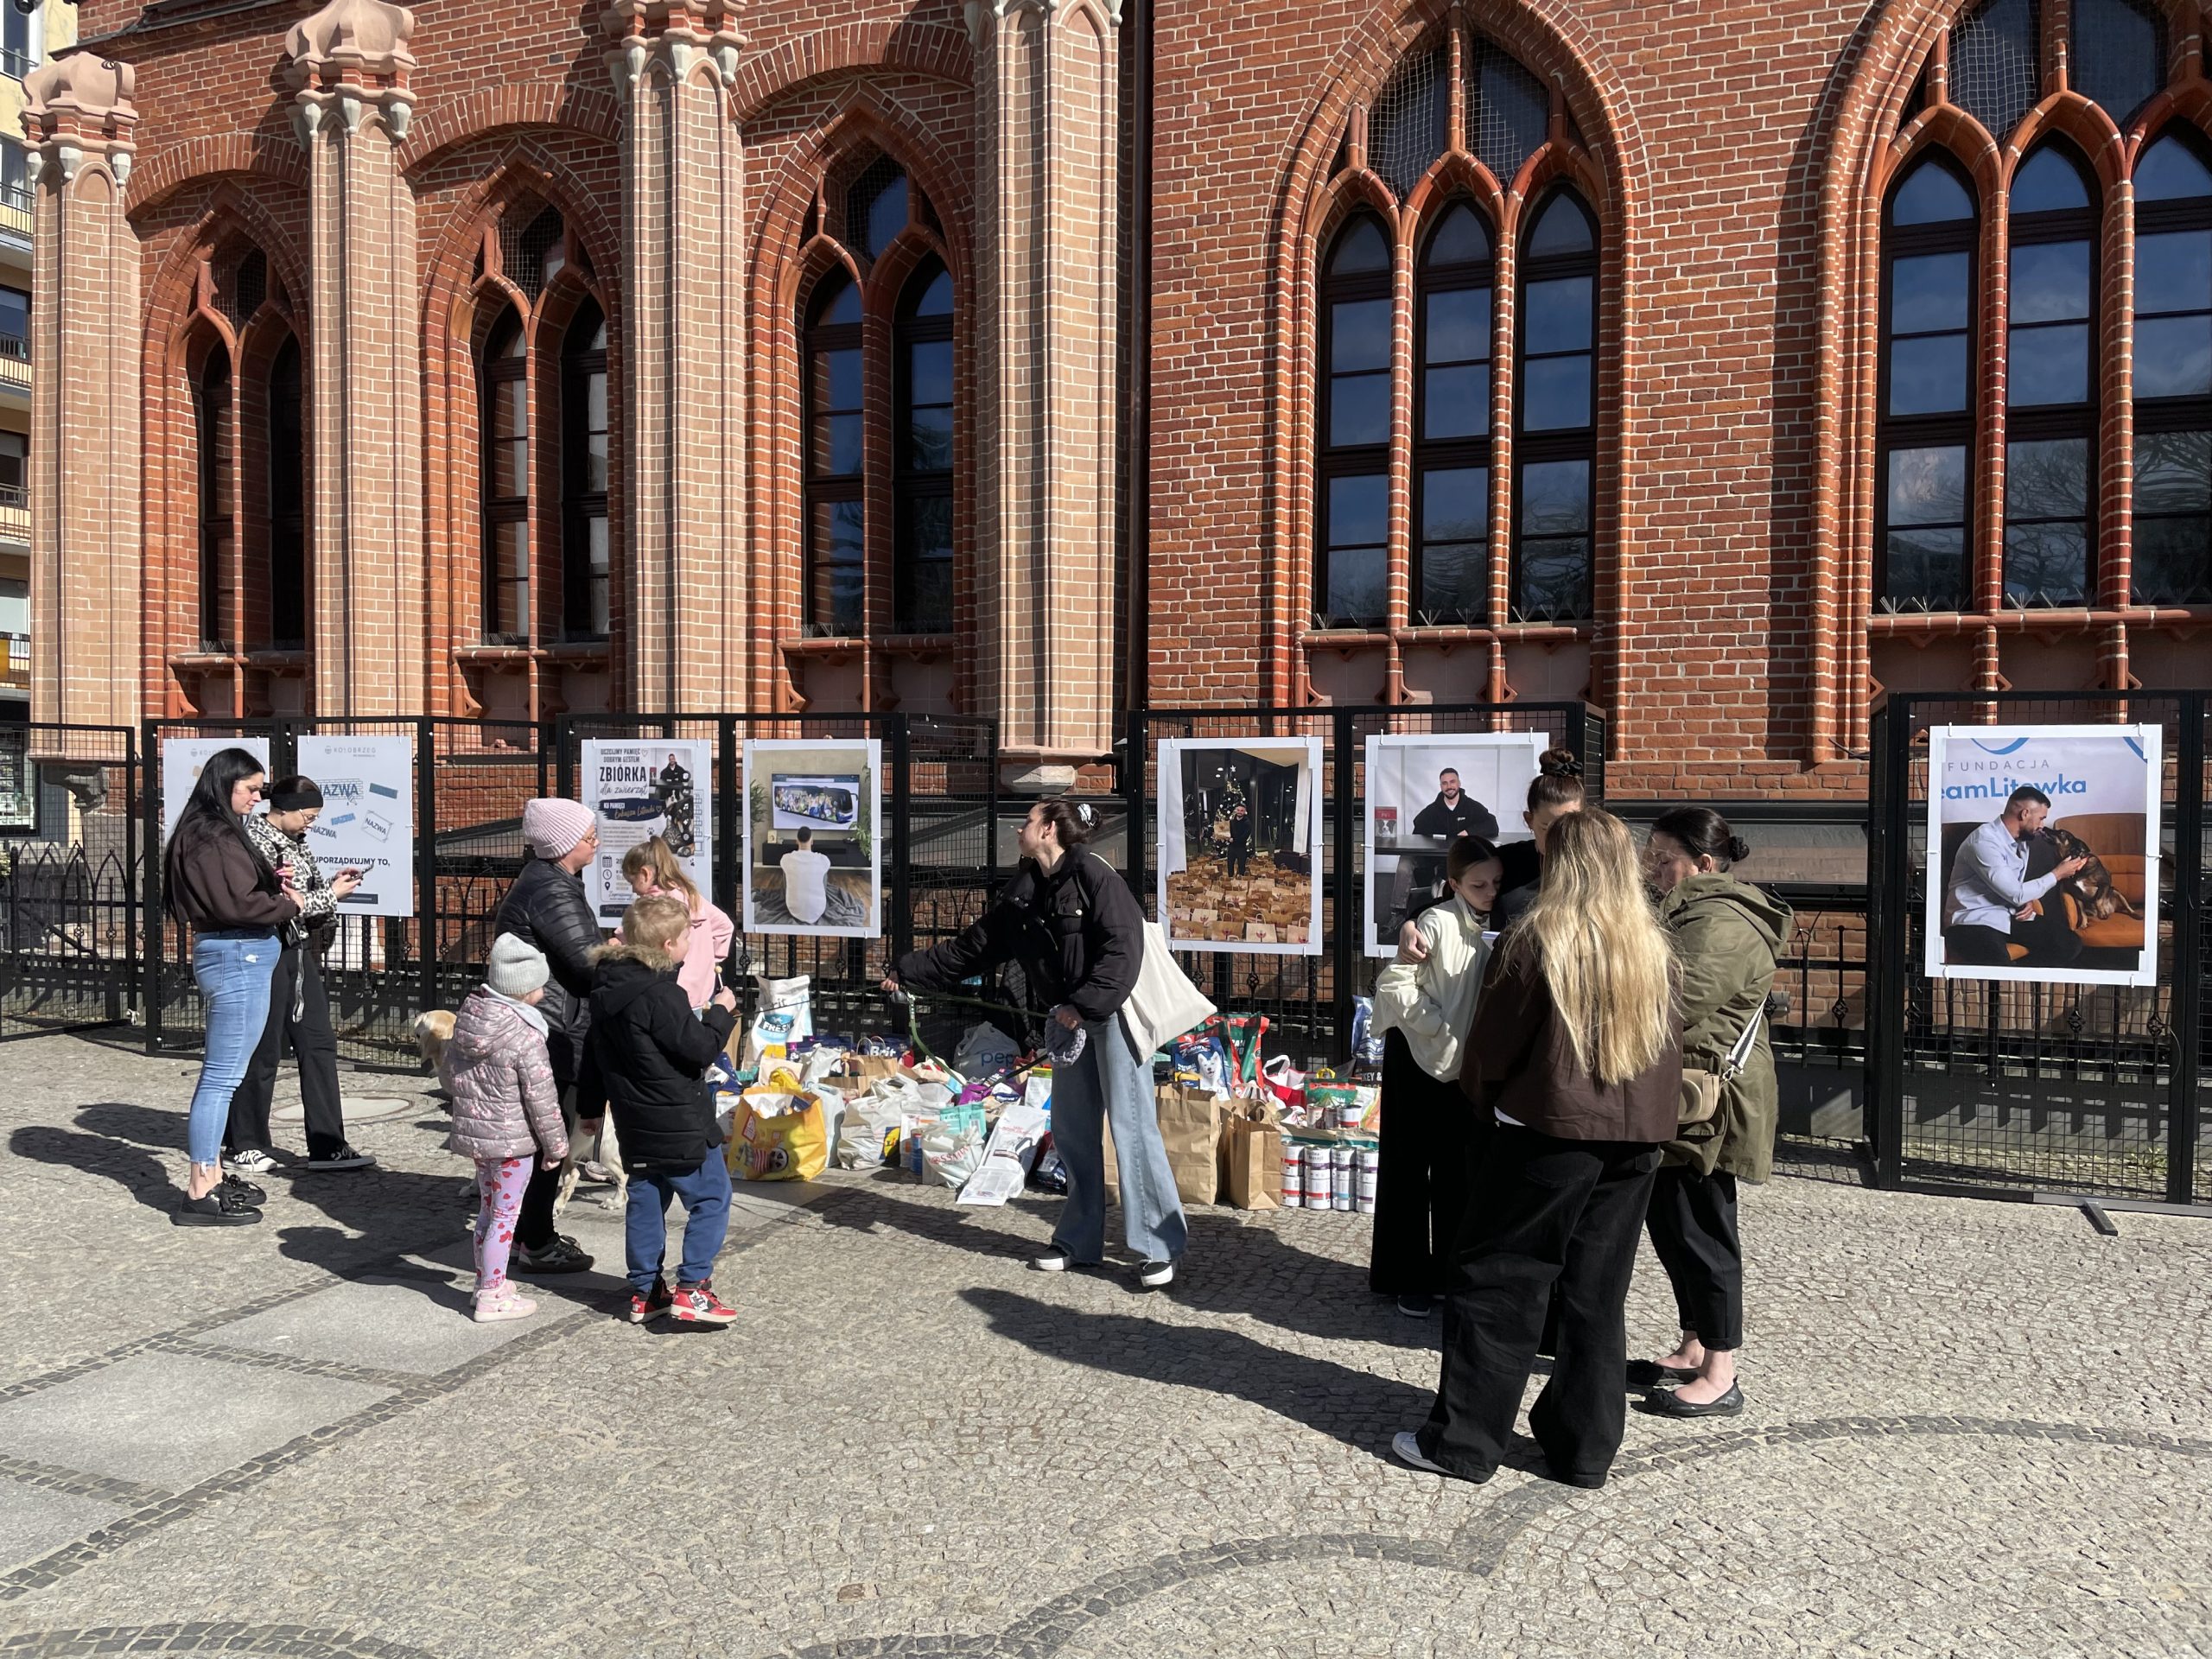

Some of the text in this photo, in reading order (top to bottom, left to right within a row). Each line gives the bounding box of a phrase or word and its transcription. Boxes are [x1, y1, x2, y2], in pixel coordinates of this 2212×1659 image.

[1948, 760, 2050, 772] FUNDACJA
[600, 764, 647, 782] ZBIÓRKA
[600, 783, 612, 796] dla
[365, 817, 386, 835] NAZWA
[378, 858, 391, 867] TO,
